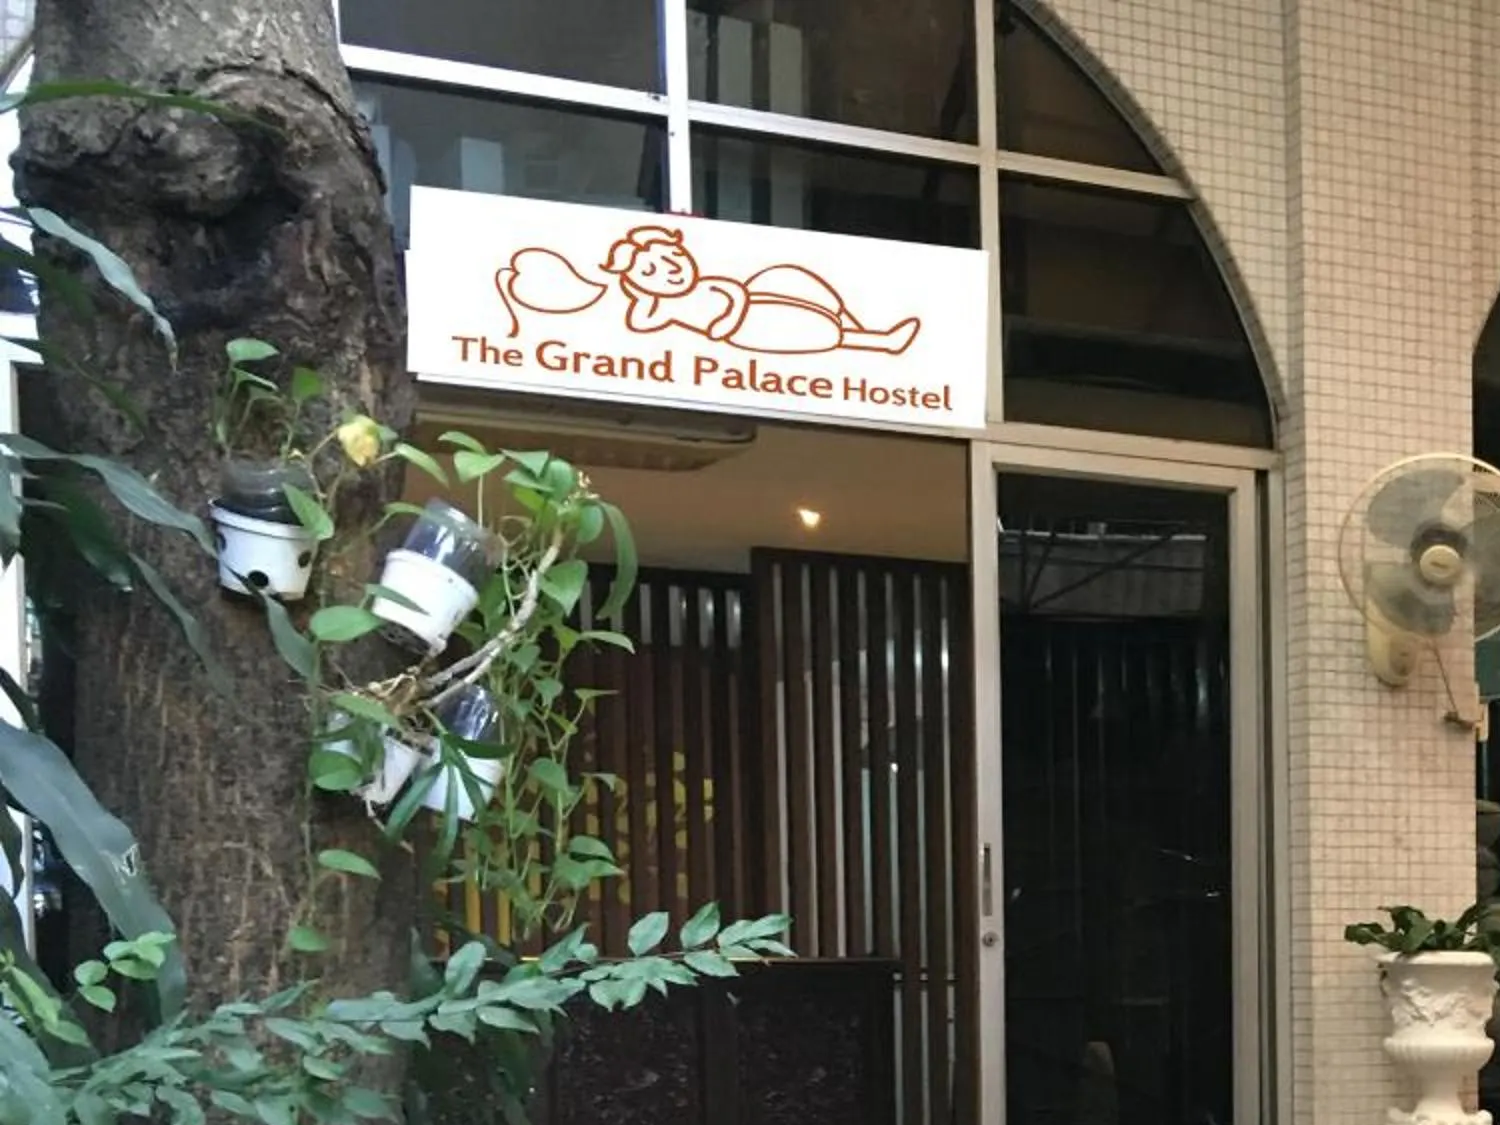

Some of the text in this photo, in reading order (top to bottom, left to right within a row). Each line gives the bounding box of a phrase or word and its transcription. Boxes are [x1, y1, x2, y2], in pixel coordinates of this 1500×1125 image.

[452, 336, 953, 411] The Grand Palace Hostel
